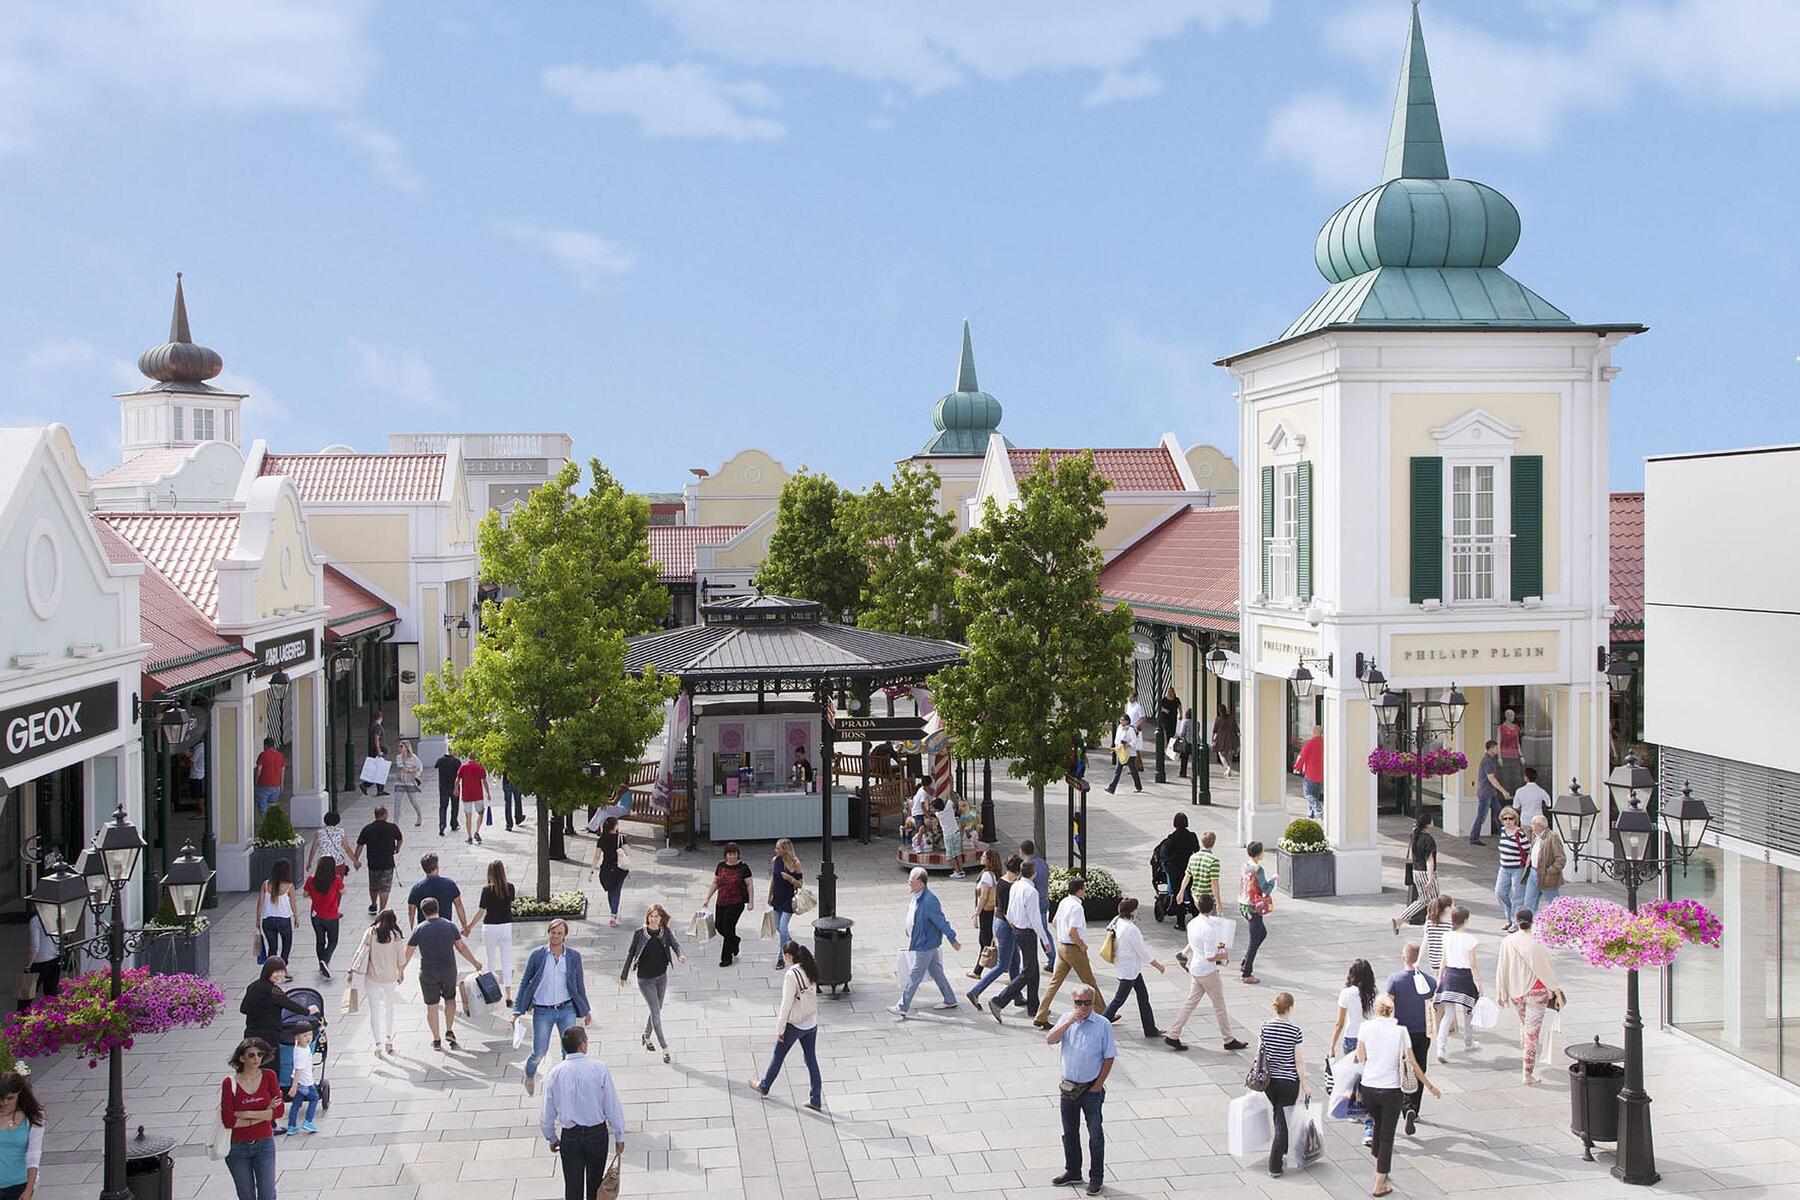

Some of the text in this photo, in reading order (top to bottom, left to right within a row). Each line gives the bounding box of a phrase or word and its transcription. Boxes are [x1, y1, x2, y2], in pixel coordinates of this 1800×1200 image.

[1404, 647, 1544, 660] PHILIPP PLEIN
[6, 701, 82, 754] GEOX
[841, 720, 876, 728] PRADA
[841, 731, 866, 739] BOSS
